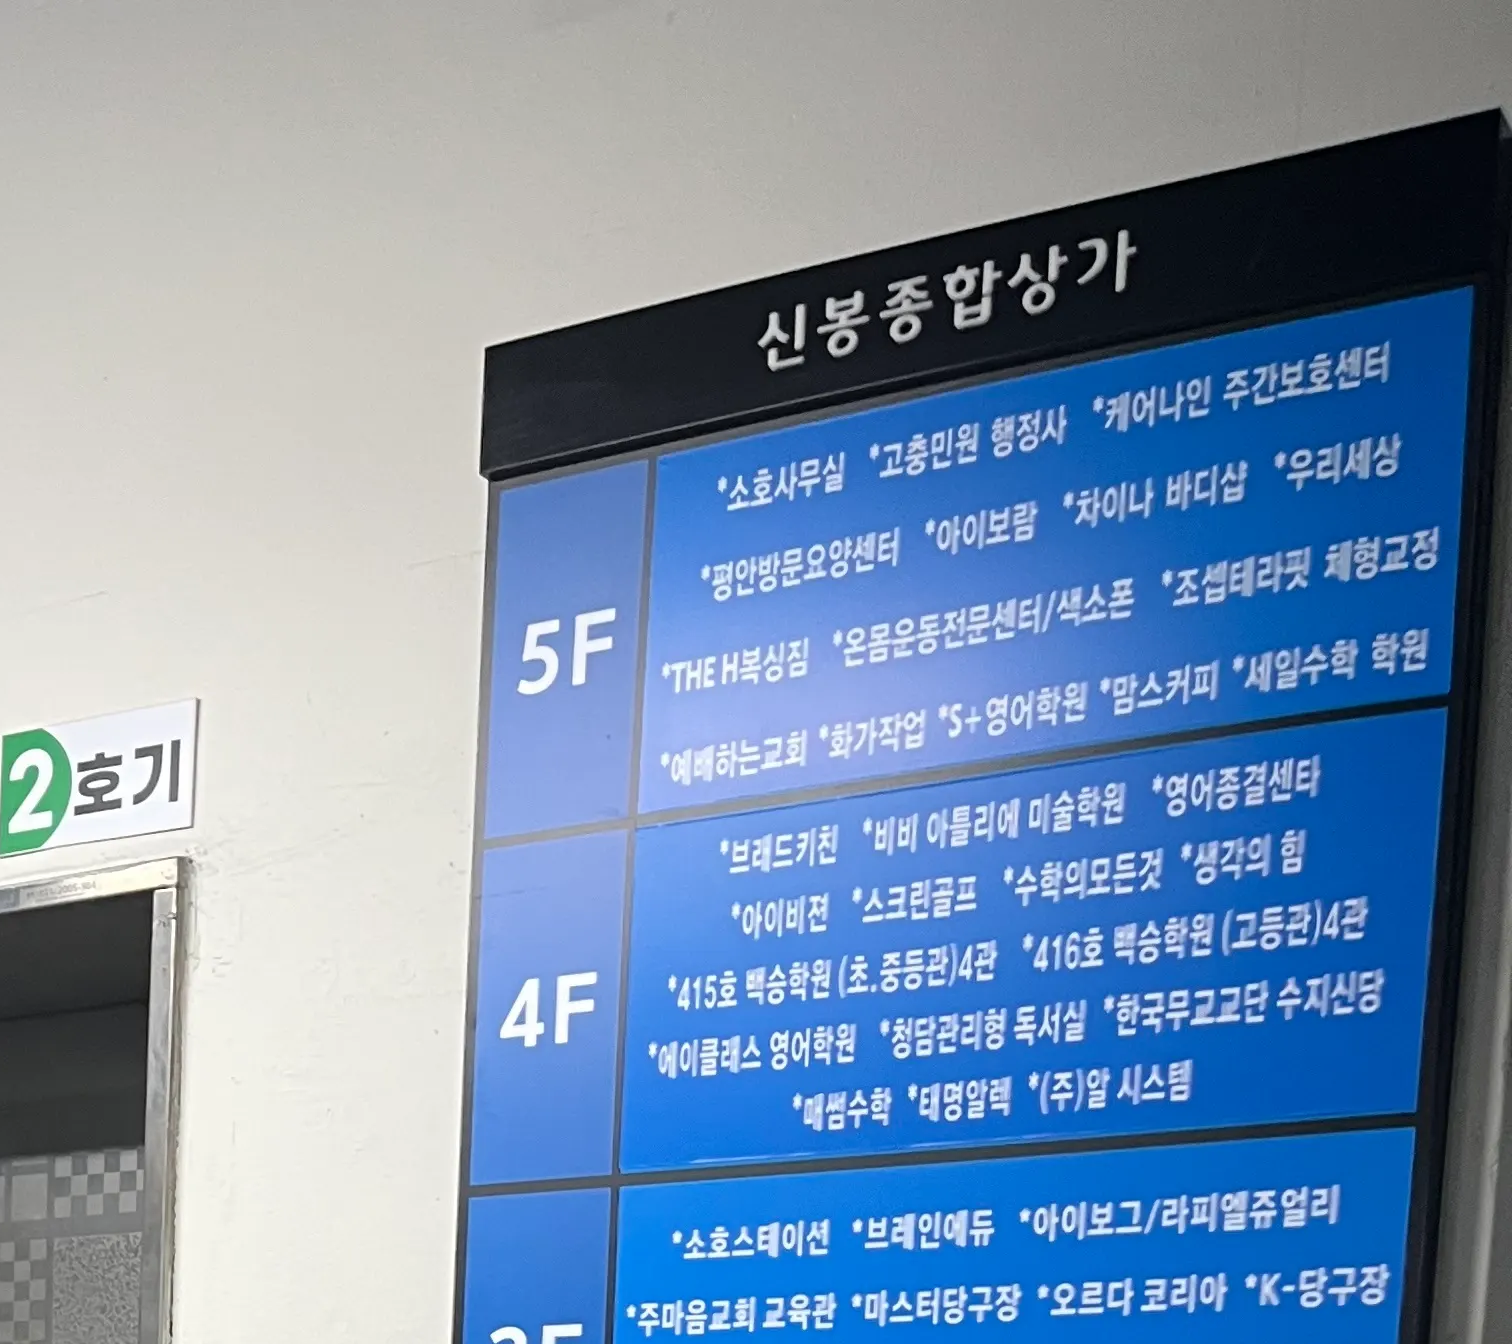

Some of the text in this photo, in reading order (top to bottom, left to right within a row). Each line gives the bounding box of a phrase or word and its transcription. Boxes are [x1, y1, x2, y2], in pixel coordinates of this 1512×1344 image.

[756, 228, 1137, 371] 신봉종합상가
[516, 606, 616, 695] 5F
[8, 738, 182, 834] 2호기
[498, 970, 598, 1048] 4F
